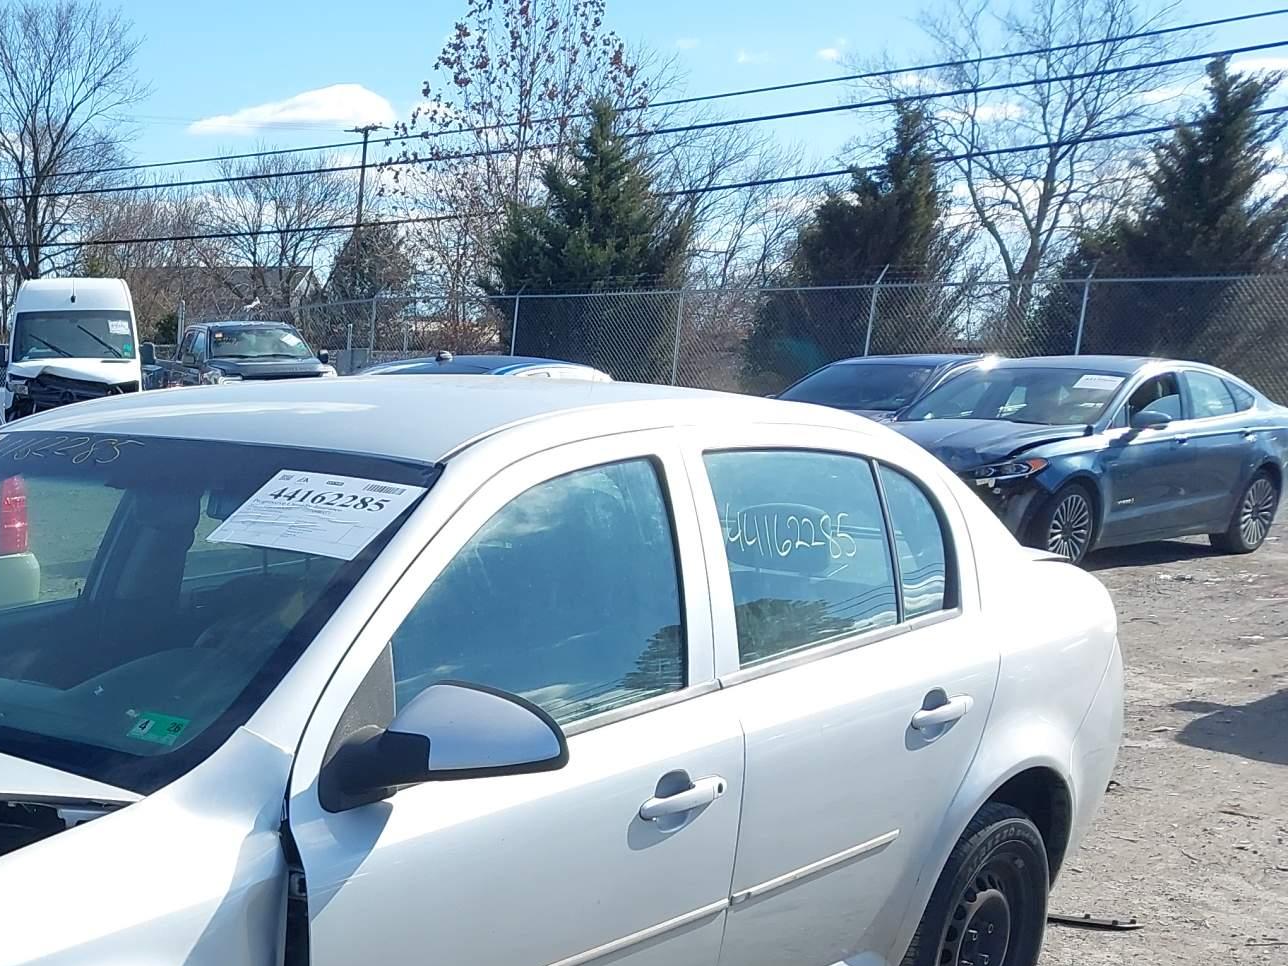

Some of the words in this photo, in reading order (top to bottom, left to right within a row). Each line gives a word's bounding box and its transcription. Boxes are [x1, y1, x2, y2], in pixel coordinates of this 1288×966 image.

[269, 486, 392, 512] 44162285
[724, 502, 857, 559] 44162285
[139, 719, 150, 730] 4
[167, 722, 184, 733] 26
